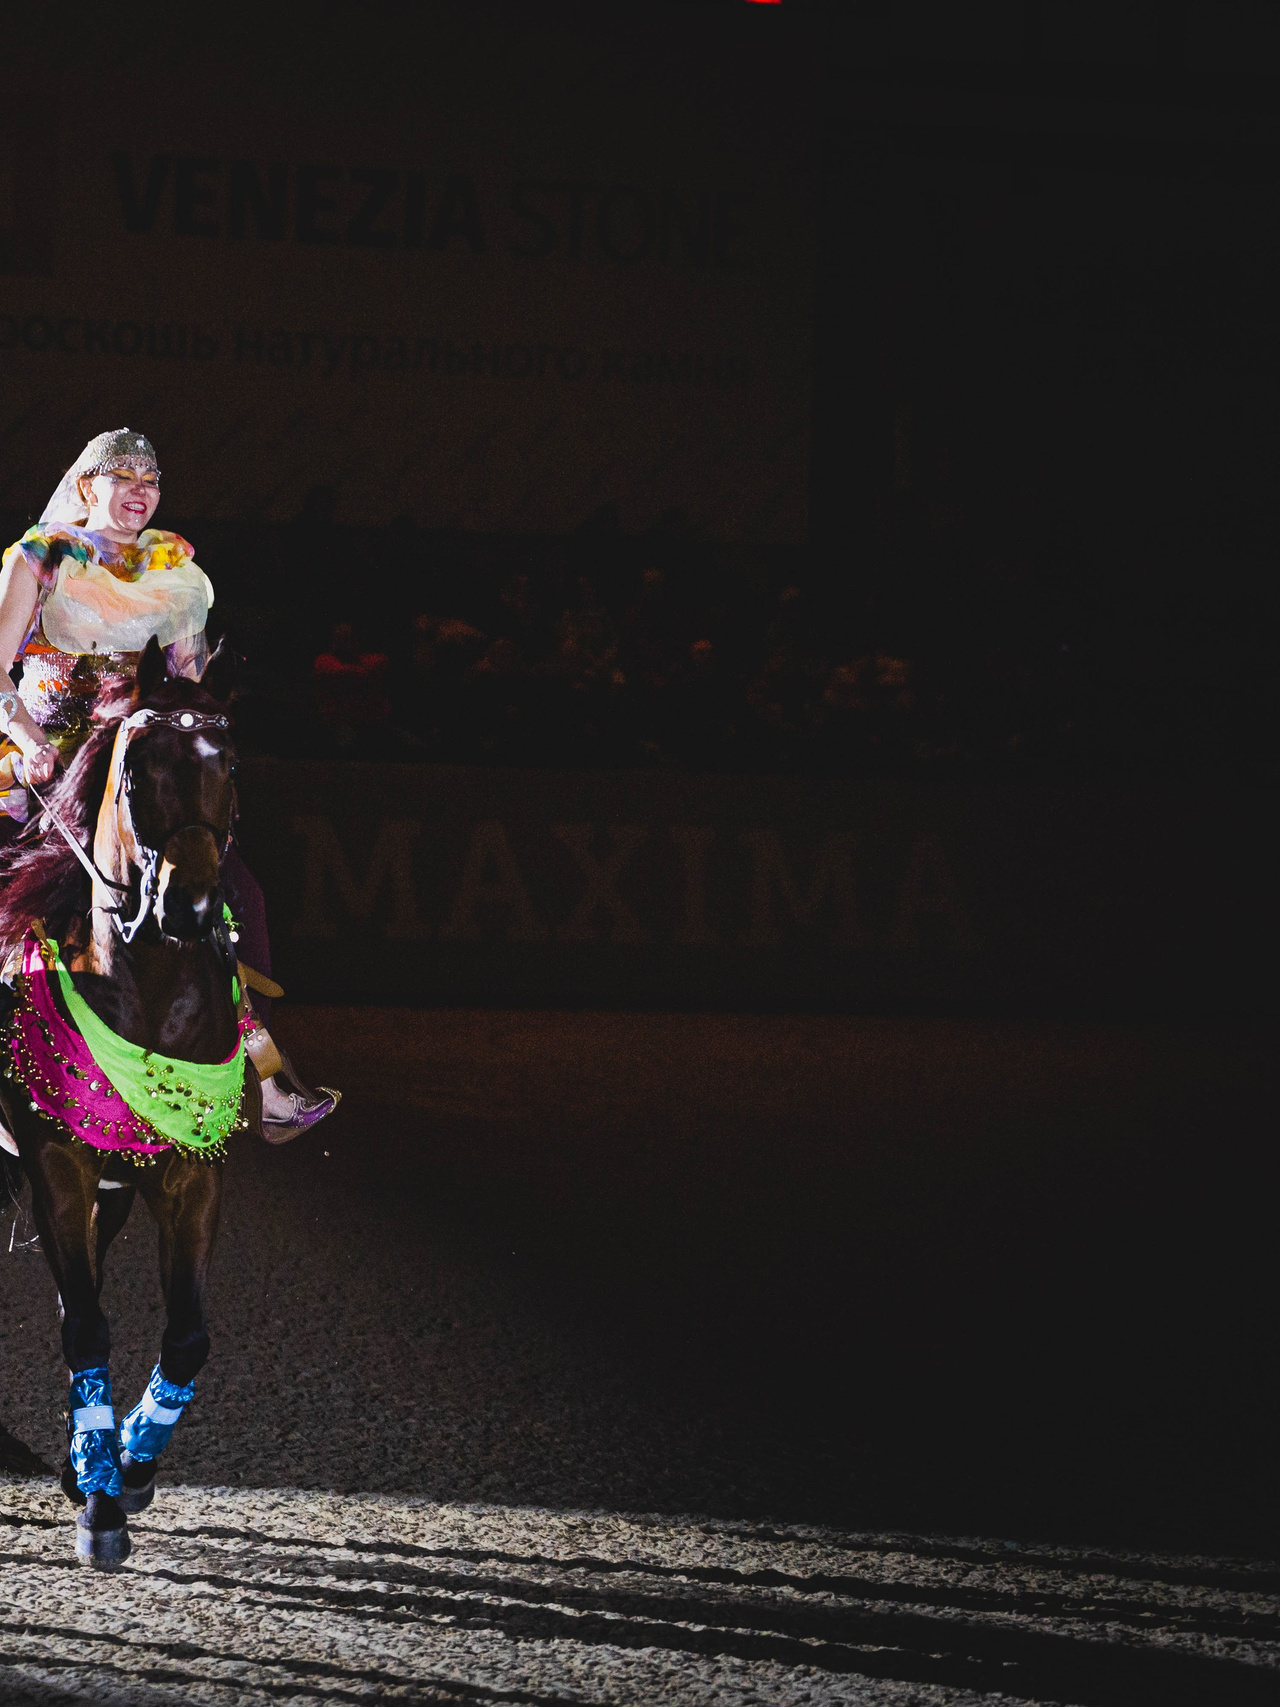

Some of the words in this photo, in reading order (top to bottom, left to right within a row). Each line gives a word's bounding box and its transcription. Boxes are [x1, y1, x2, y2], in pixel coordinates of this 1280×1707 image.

[110, 150, 486, 253] VENEZIA
[505, 177, 756, 271] STONE
[291, 813, 984, 952] MAXIMA
